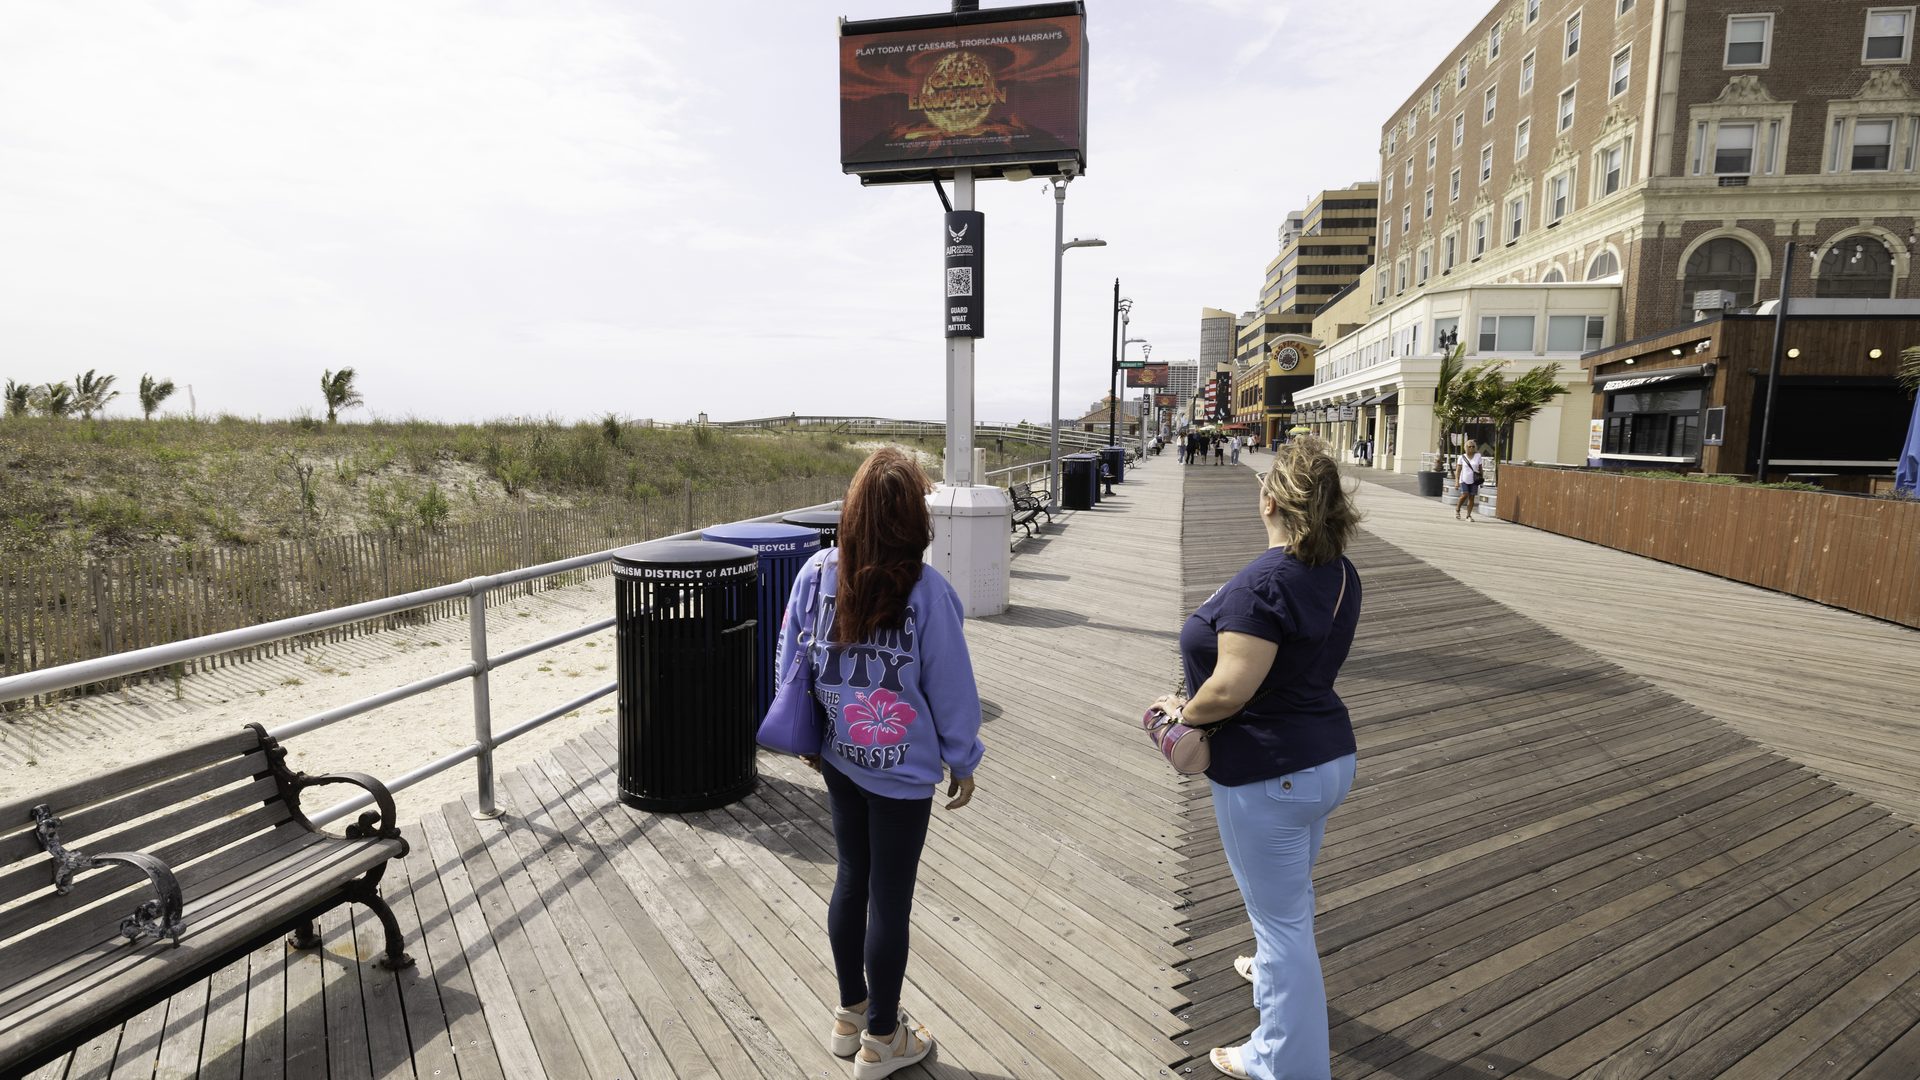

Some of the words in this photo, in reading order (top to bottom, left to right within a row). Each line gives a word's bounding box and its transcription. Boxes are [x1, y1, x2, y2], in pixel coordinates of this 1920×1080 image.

[856, 48, 875, 56] PLAY
[878, 46, 904, 54] TODAY
[906, 44, 917, 52] AT
[918, 41, 958, 51] CAESARS,
[960, 36, 1009, 47] TROPICANA
[1018, 31, 1063, 43] HARRAH'S
[951, 306, 968, 314] GUARD
[753, 543, 796, 552] RECYCLE
[645, 569, 702, 579] DISTRICT
[706, 568, 717, 578] of
[837, 742, 910, 769] JERSEY
